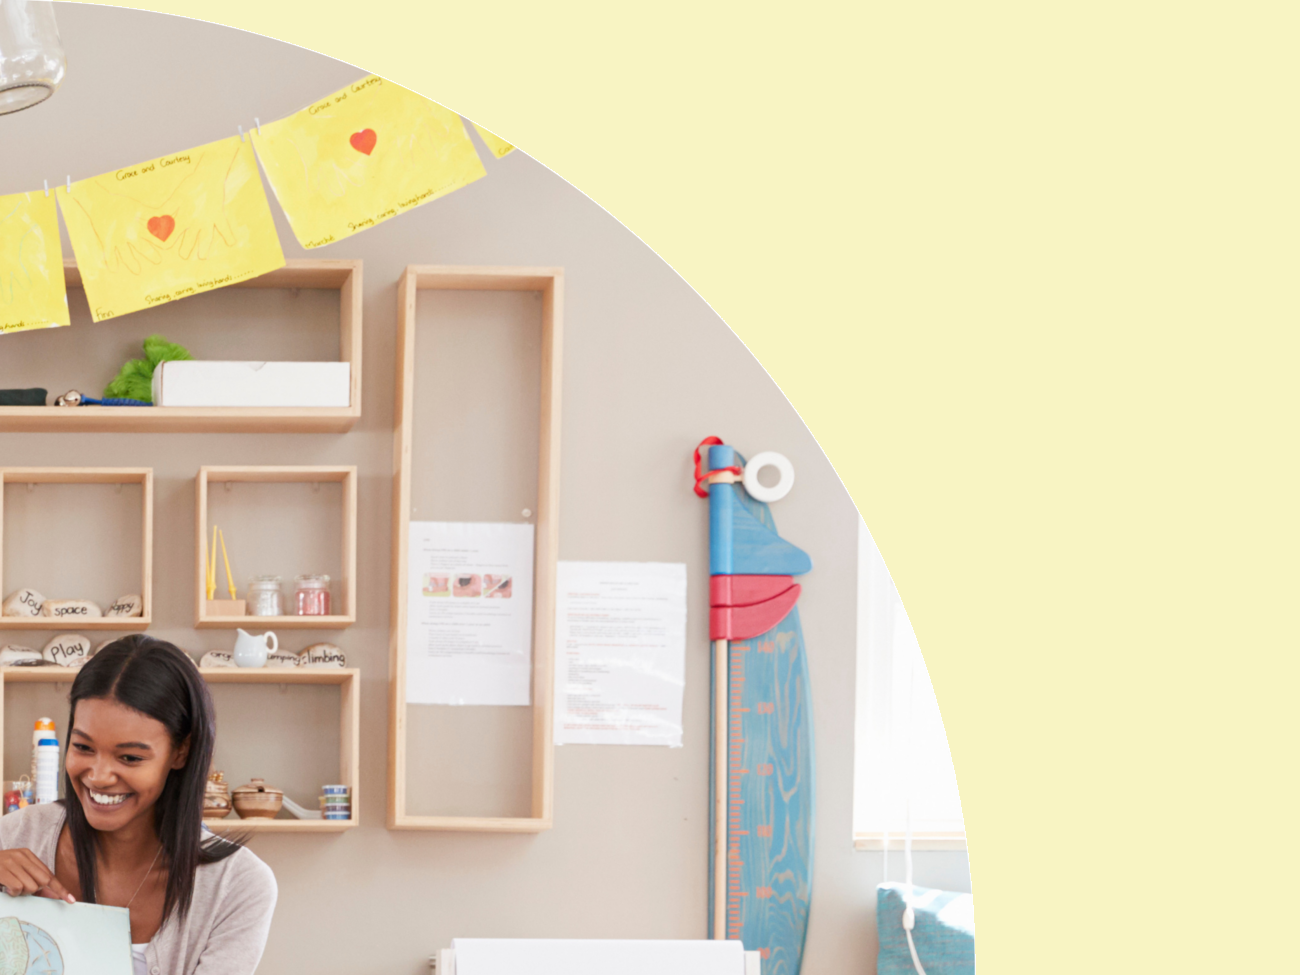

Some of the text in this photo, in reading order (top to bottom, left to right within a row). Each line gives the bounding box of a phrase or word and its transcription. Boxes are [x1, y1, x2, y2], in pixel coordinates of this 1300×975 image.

[309, 101, 332, 116] Grace
[335, 92, 348, 104] and
[116, 169, 138, 182] Grace
[141, 163, 155, 174] and
[95, 307, 114, 321] Finn
[20, 591, 42, 616] Joy
[54, 605, 87, 617] space
[757, 641, 775, 653] 140
[267, 654, 300, 666] umping
[757, 702, 774, 715] 130
[757, 763, 774, 776] 120
[757, 825, 772, 838] 110
[756, 886, 772, 898] 100
